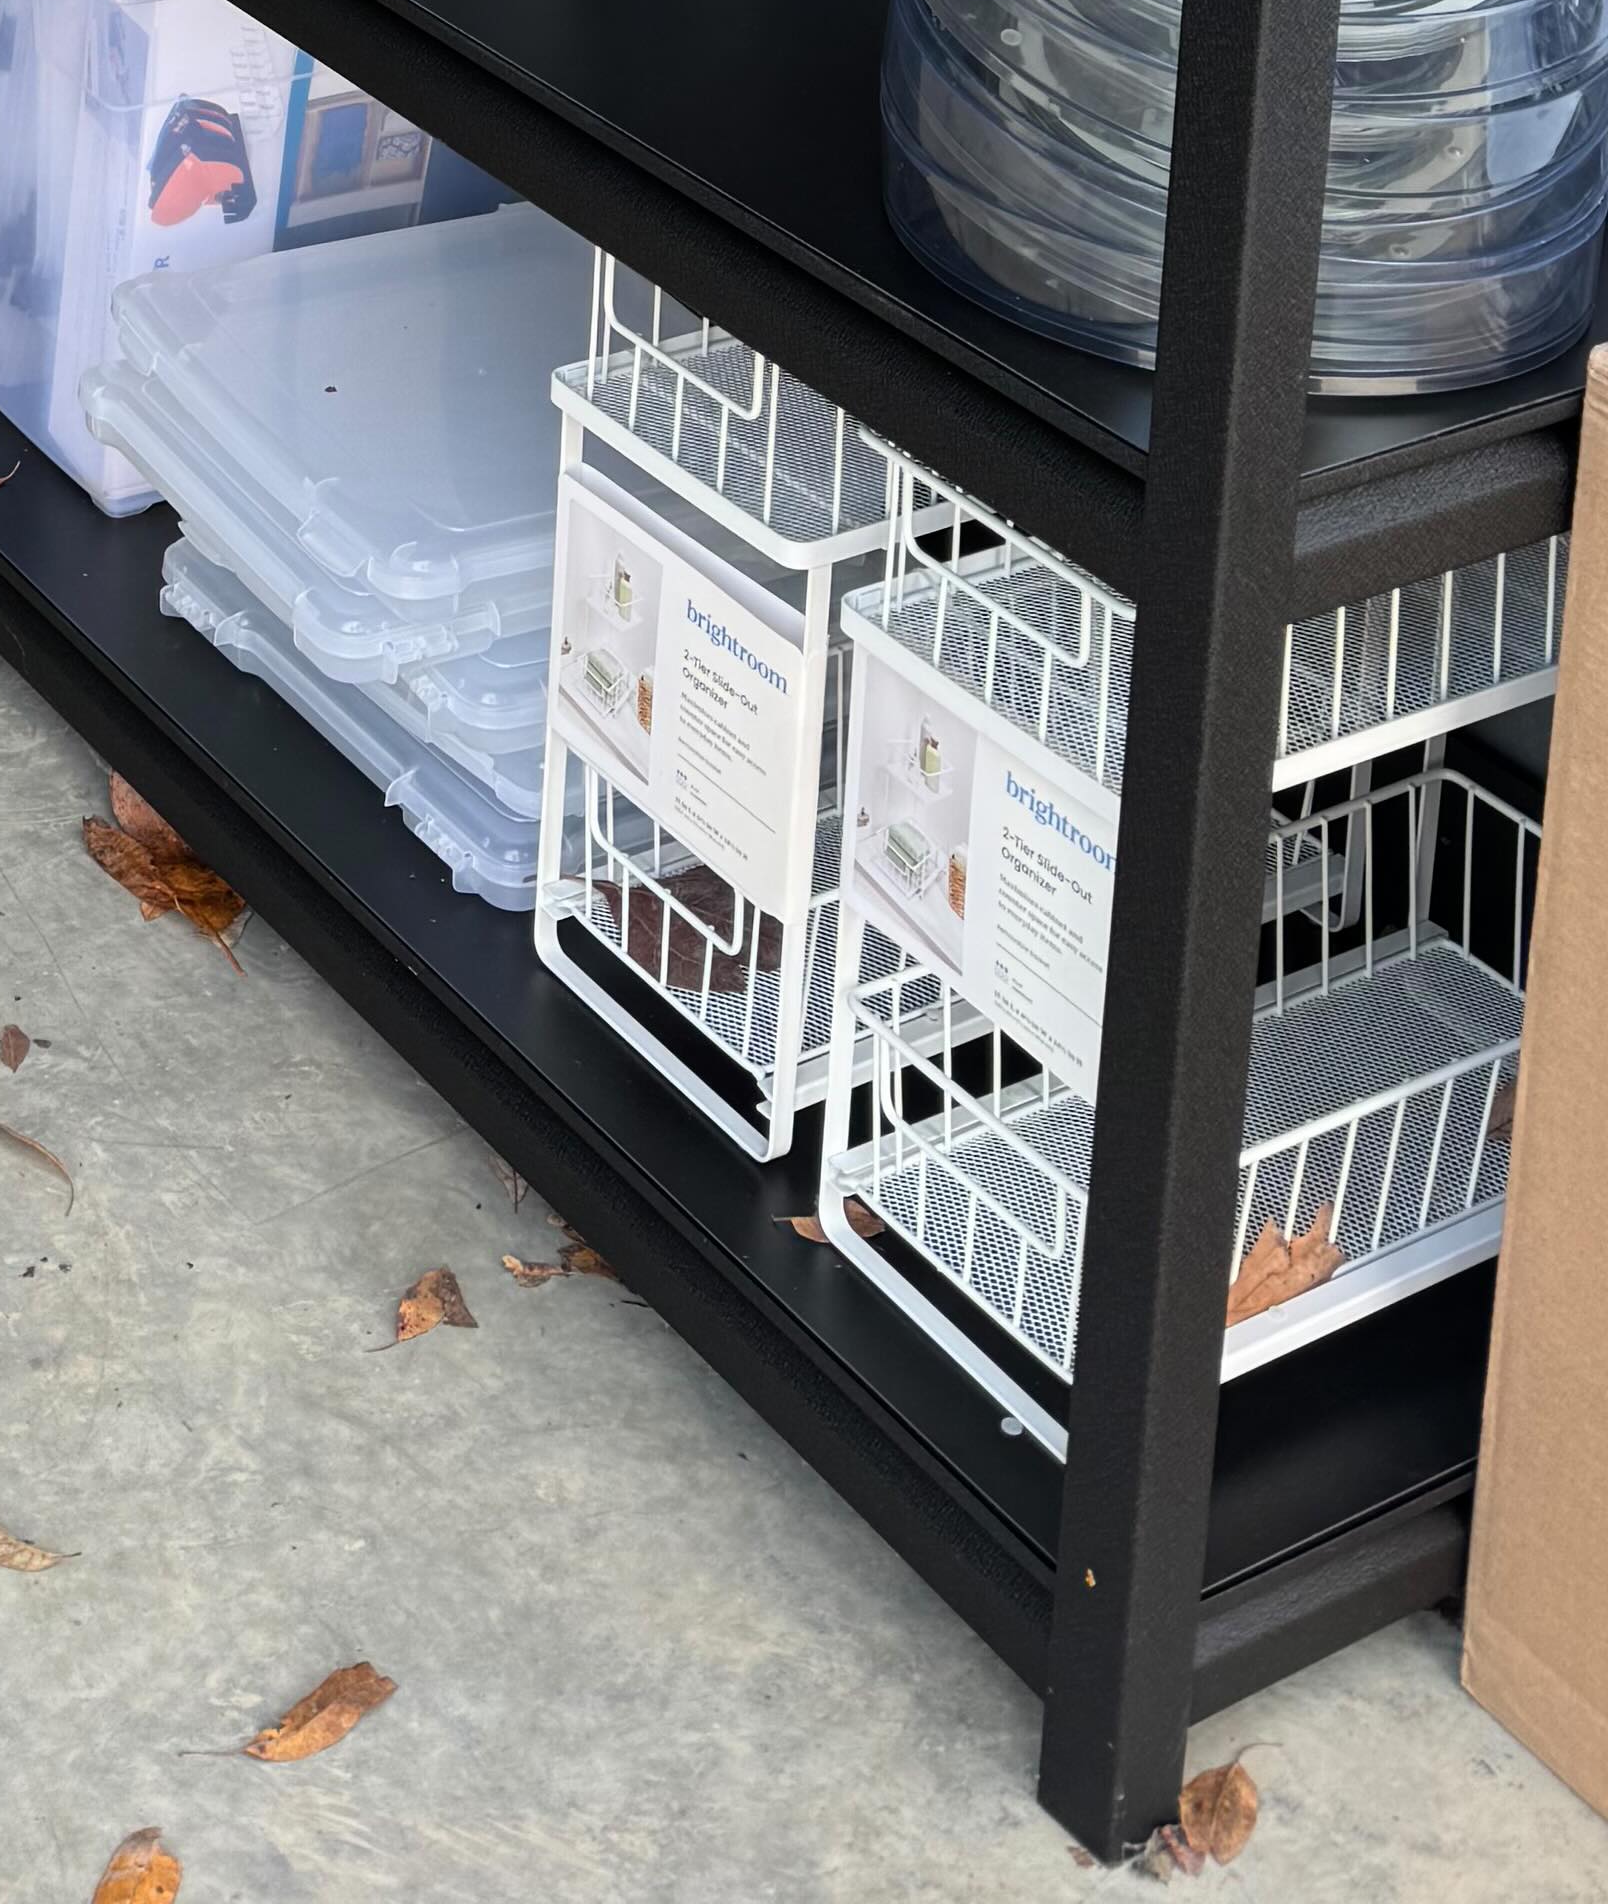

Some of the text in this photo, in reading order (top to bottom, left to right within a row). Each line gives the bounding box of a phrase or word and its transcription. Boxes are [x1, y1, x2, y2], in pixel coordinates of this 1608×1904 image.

[686, 599, 789, 695] brightroom
[682, 667, 729, 710] Organizer
[683, 649, 759, 716] 2-Tier Slide-Out
[1001, 846, 1057, 897] Organizer
[1002, 826, 1093, 905] 2-Tier Slide-Out
